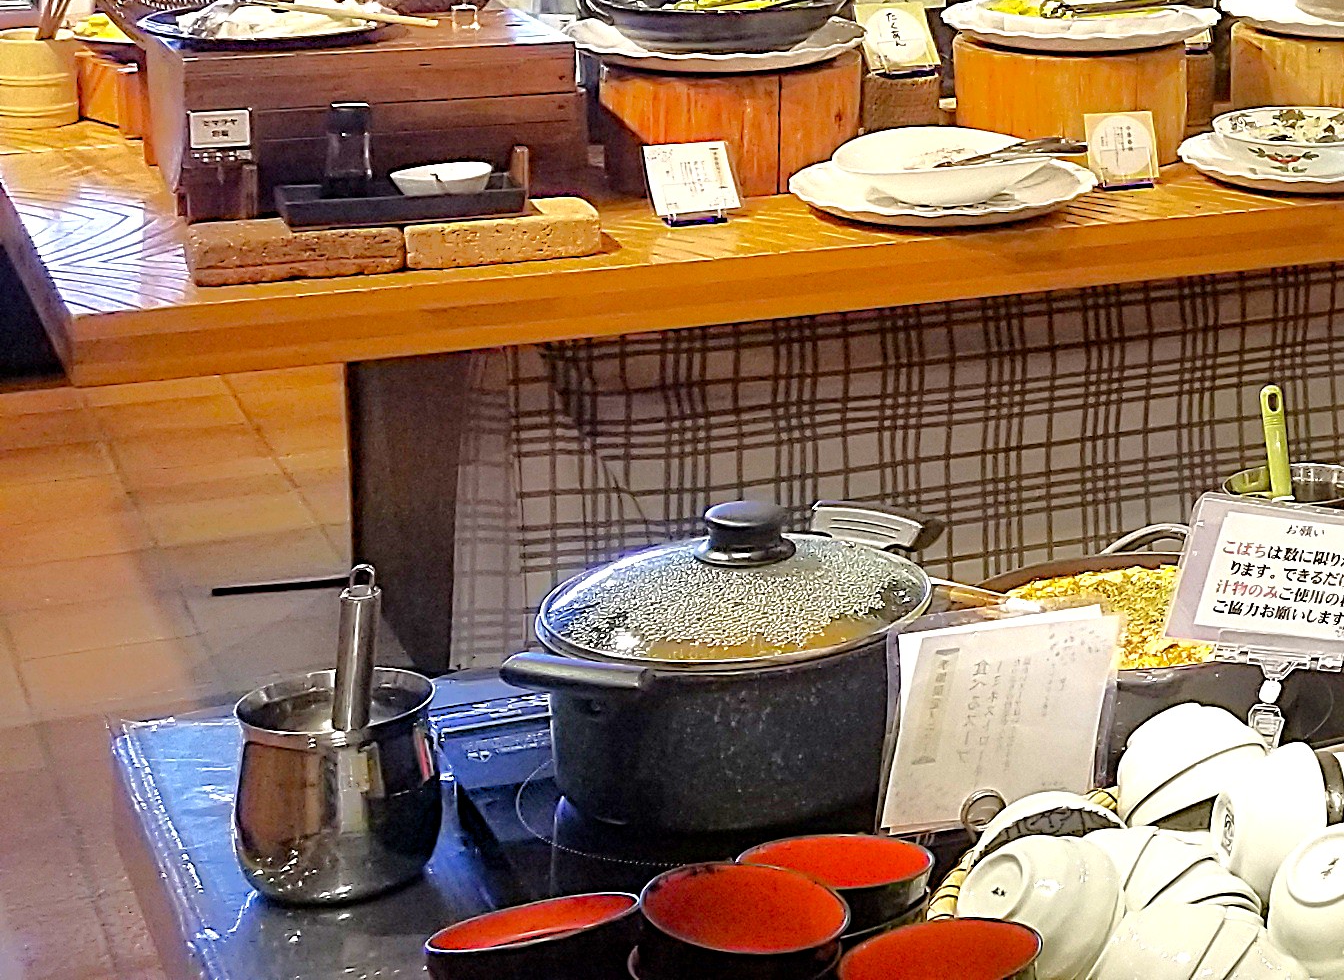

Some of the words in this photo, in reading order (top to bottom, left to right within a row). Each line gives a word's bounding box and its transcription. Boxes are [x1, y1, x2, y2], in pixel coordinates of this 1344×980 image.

[885, 12, 907, 47] たくあん
[1286, 524, 1325, 538] お願い
